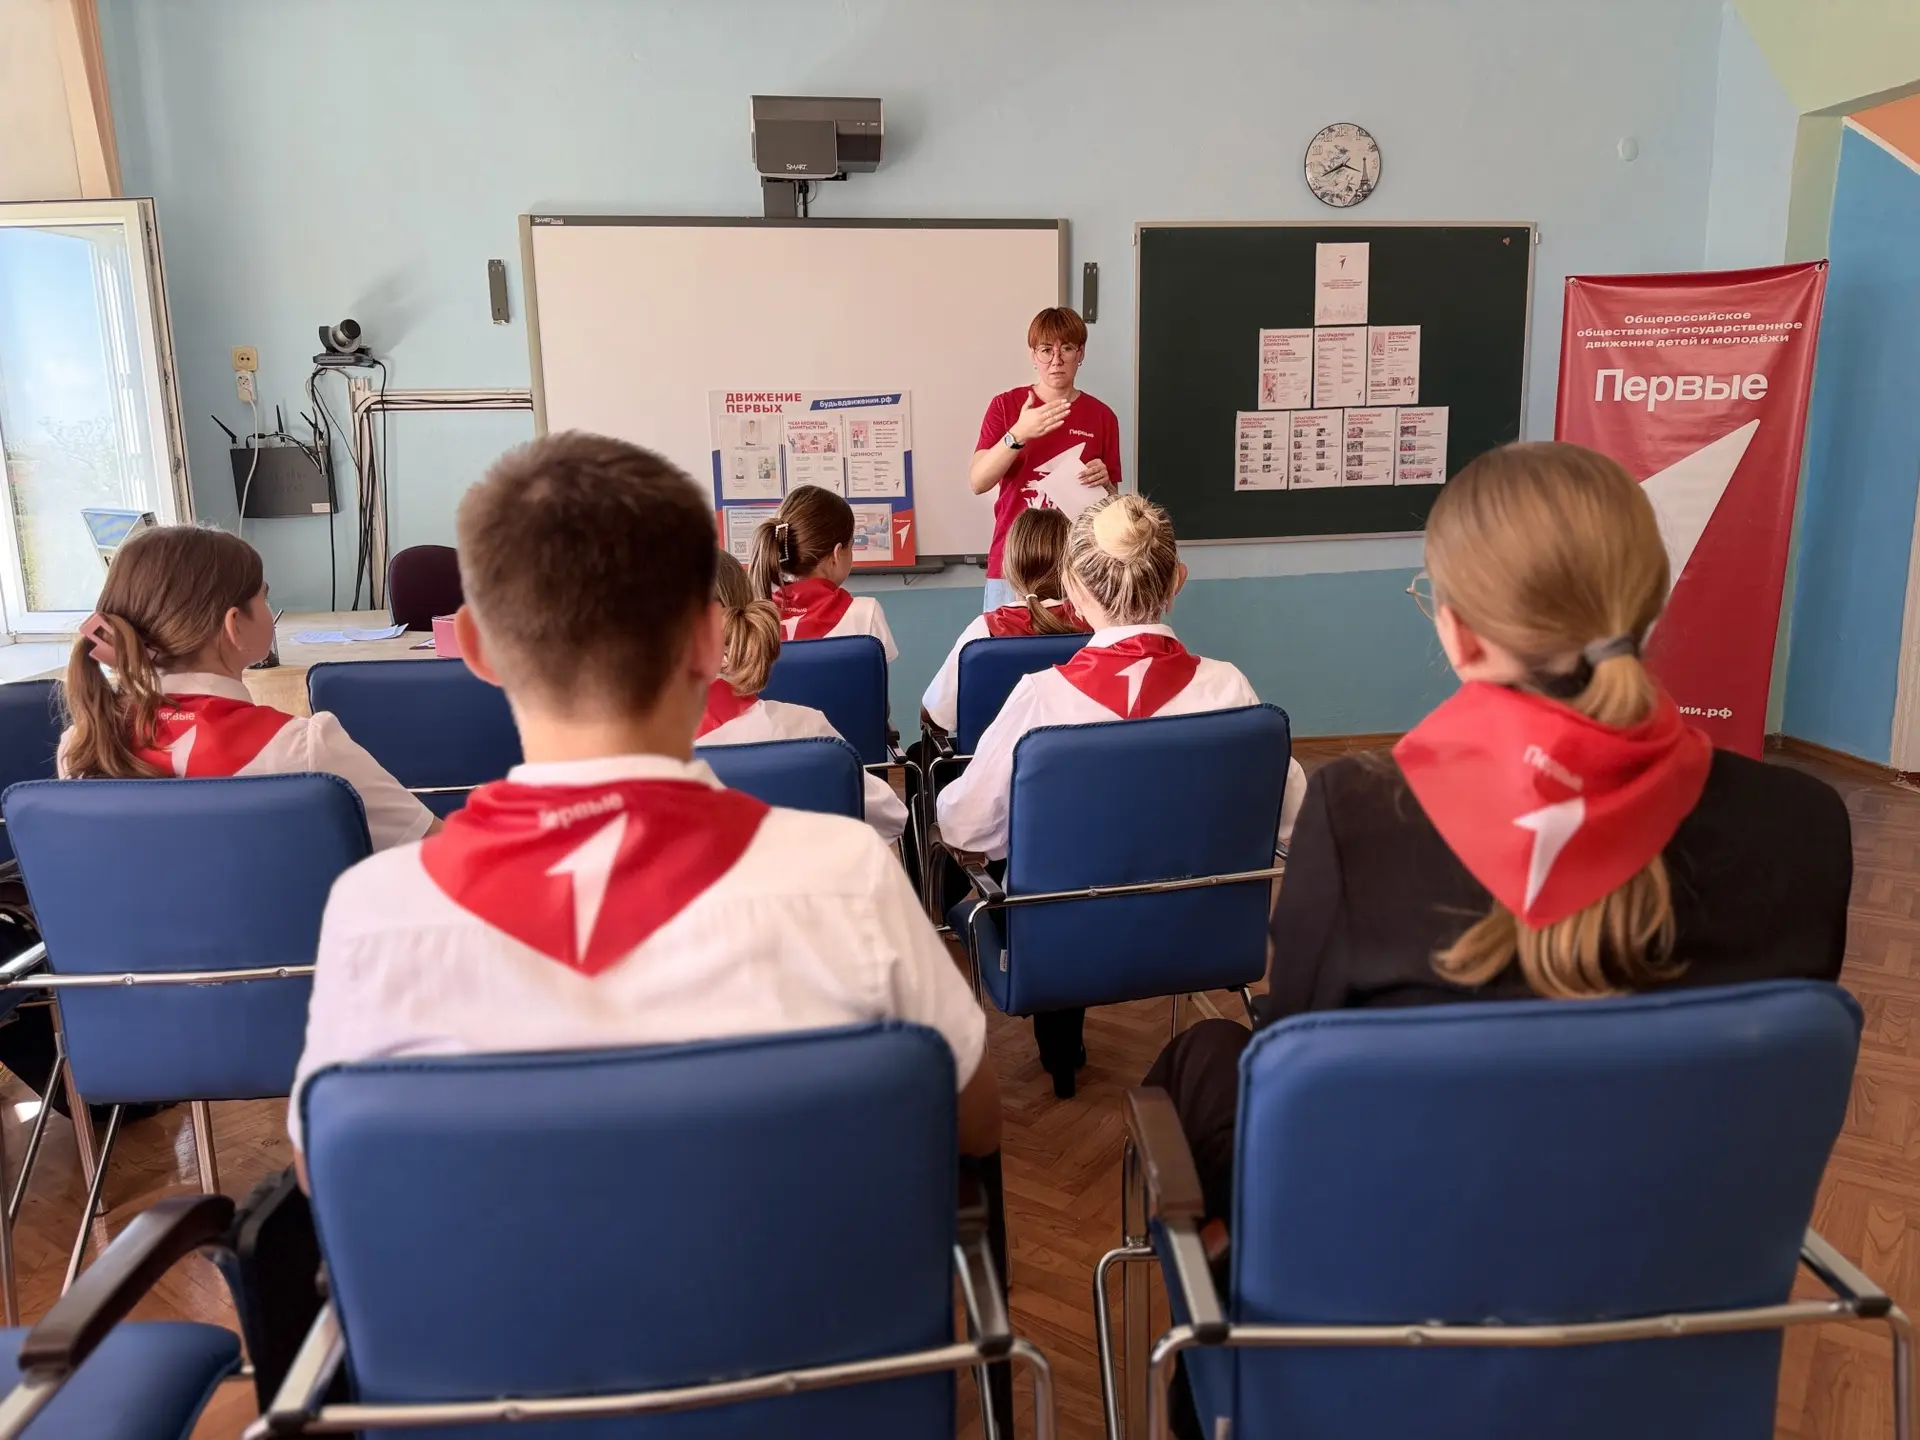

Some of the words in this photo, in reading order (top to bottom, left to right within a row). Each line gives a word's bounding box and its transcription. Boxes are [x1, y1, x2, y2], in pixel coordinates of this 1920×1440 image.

[1624, 311, 1751, 324] Общероссийское
[1577, 321, 1803, 338] общественно-государственное
[1585, 339, 1654, 349] движение
[1656, 337, 1697, 348] детей
[1712, 334, 1789, 346] молодёжи
[1594, 368, 1768, 412] Первые
[725, 393, 802, 404] ДВИЖЕНИЕ
[819, 396, 893, 408] будьвдвижении.рф
[726, 404, 783, 413] ПЕРВЫХ
[1069, 428, 1094, 438] Первые
[1678, 705, 1733, 719] ии.рф
